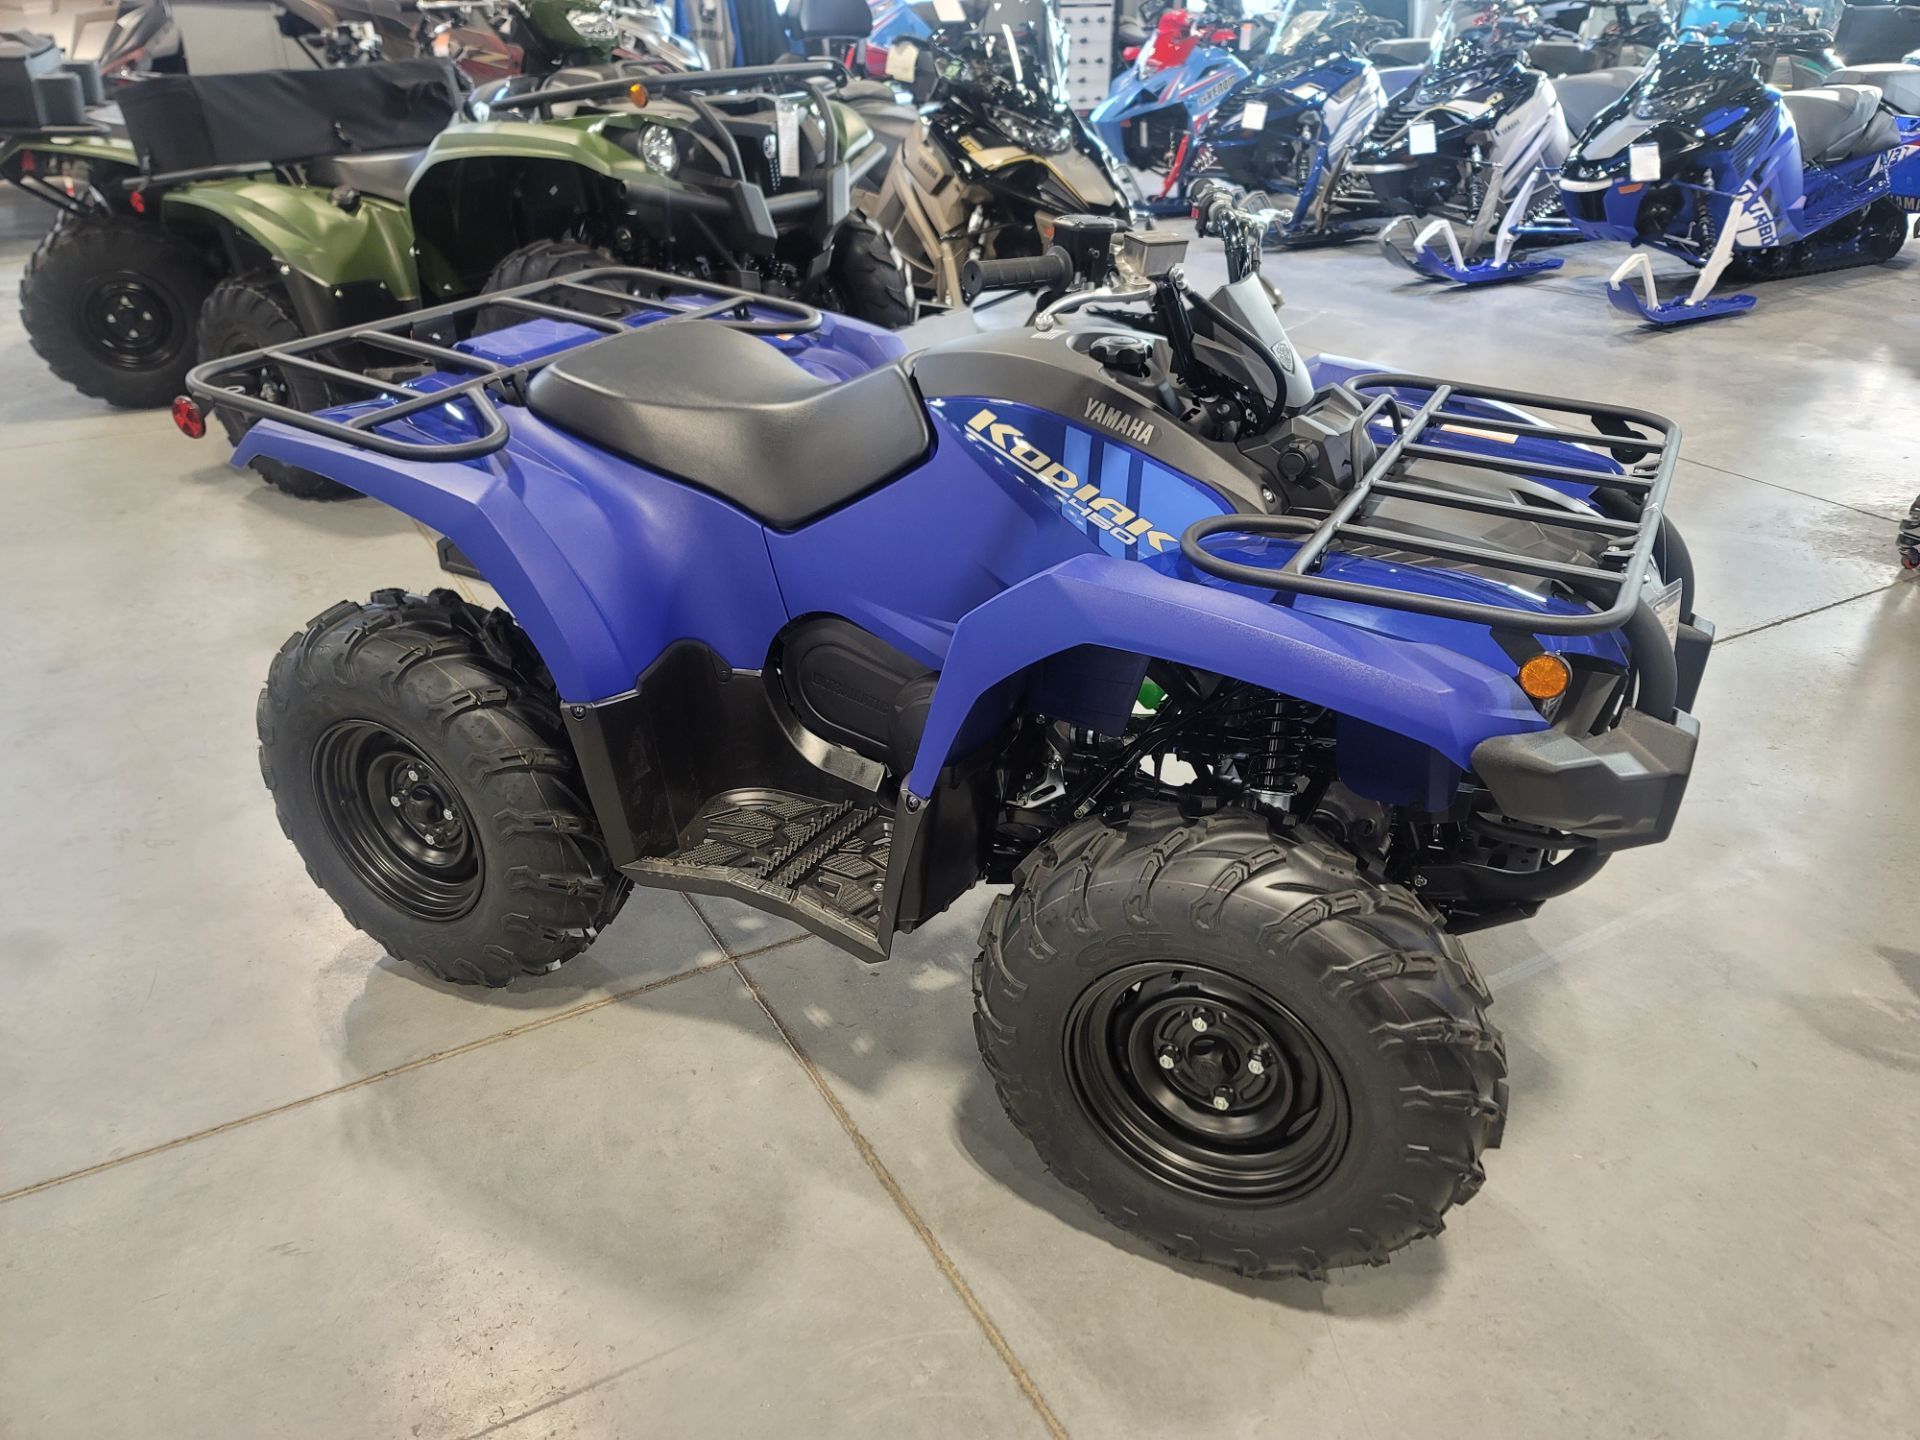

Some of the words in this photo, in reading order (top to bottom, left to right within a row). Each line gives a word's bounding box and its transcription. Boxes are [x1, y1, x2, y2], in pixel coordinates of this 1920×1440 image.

[1083, 397, 1154, 445] YAMAHA
[966, 408, 1179, 553] KODIAK
[1067, 498, 1138, 546] 450
